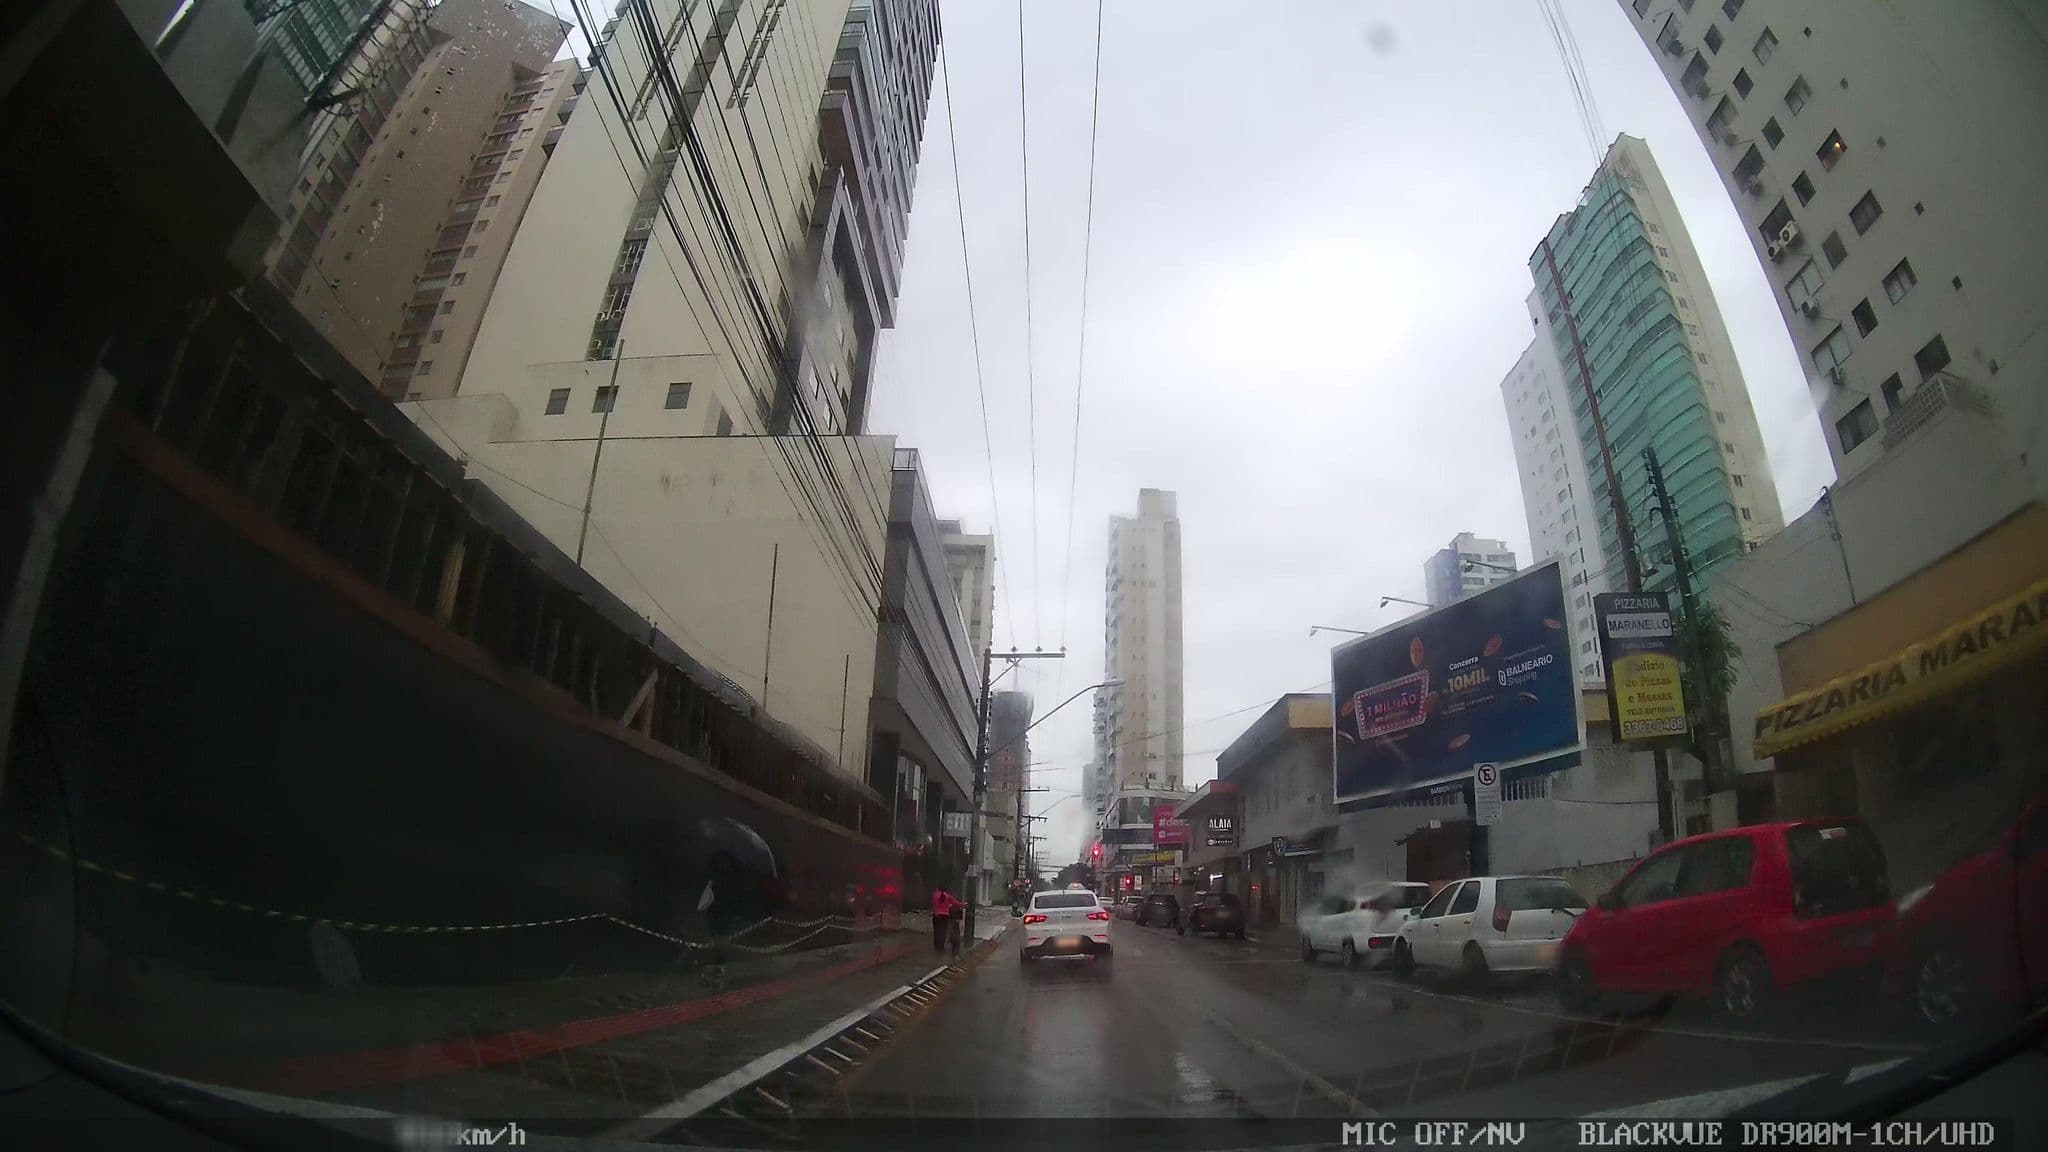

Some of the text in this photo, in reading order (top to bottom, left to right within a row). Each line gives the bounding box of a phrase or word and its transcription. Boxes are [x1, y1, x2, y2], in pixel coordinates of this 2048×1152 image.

[1614, 597, 1661, 610] PIZZARIA
[1608, 617, 1671, 633] MARANELLO
[1507, 670, 1537, 686] Shopping
[1640, 675, 1672, 687] Pizzas
[1374, 692, 1417, 714] MILHÃO
[1637, 692, 1673, 703] Massas
[1754, 663, 1907, 739] PIZZARIA
[1208, 818, 1232, 829] ALAIA
